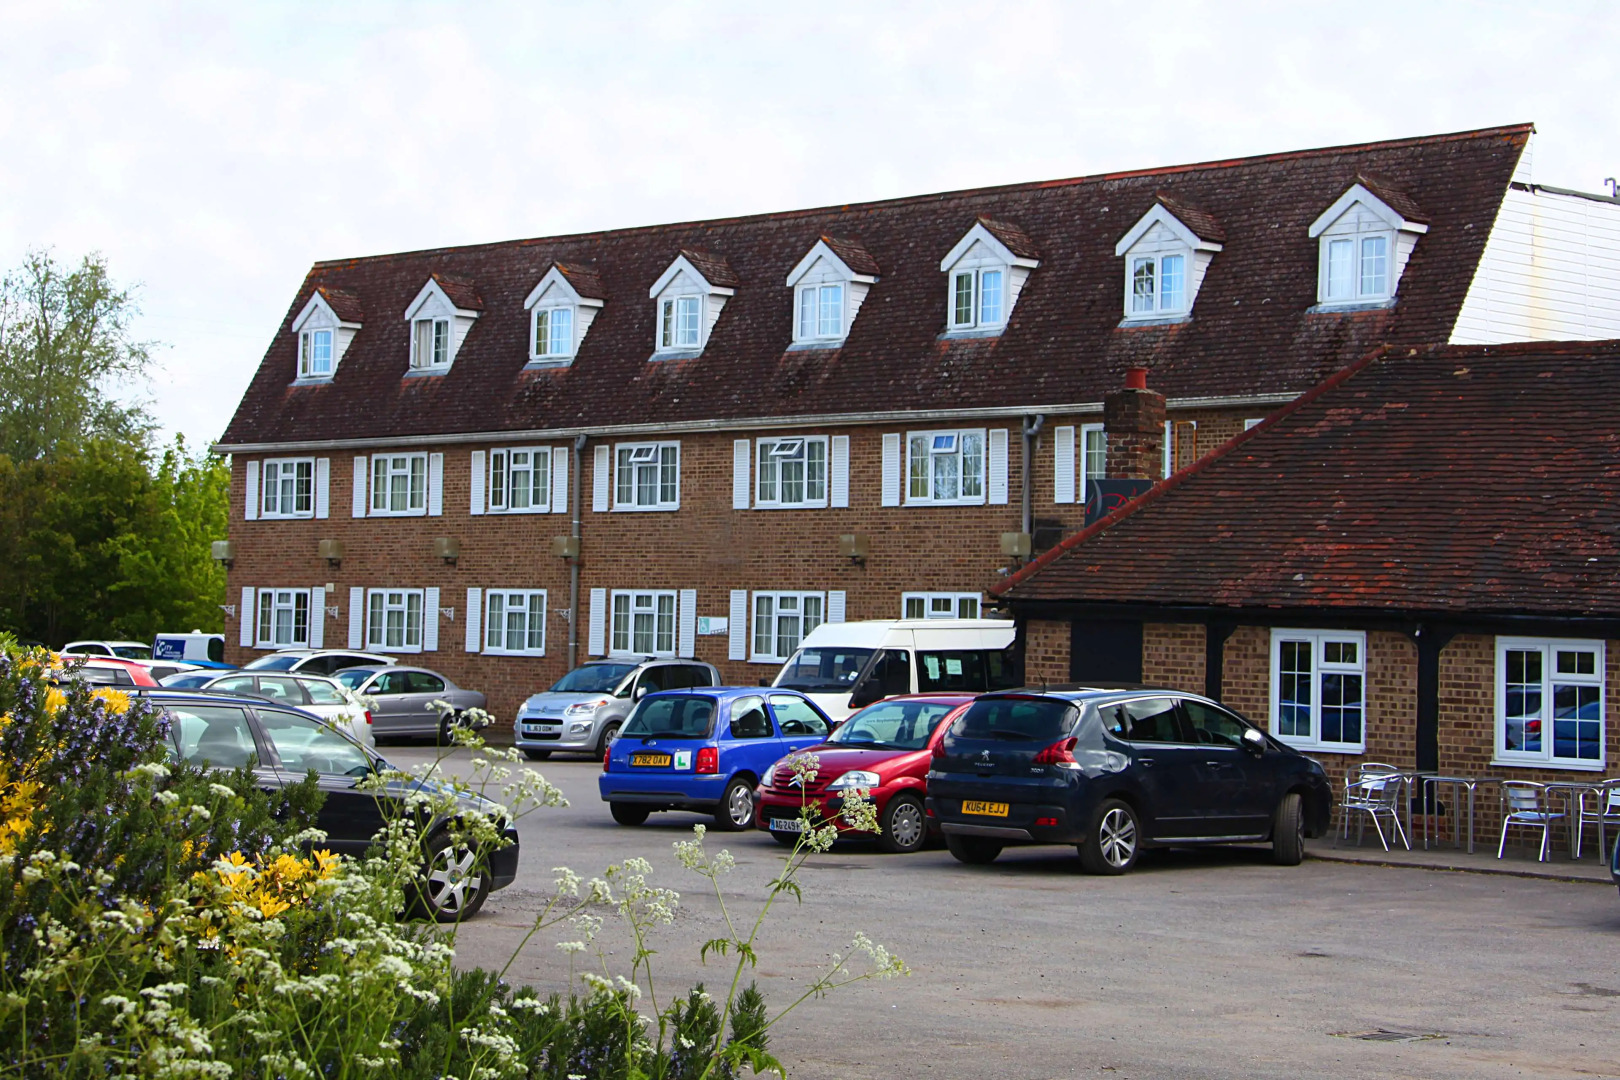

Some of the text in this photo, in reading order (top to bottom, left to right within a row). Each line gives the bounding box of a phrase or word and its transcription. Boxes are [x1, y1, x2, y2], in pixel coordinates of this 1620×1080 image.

[632, 755, 652, 764] X782
[678, 756, 686, 766] L
[966, 801, 1005, 814] KU64 EJJ
